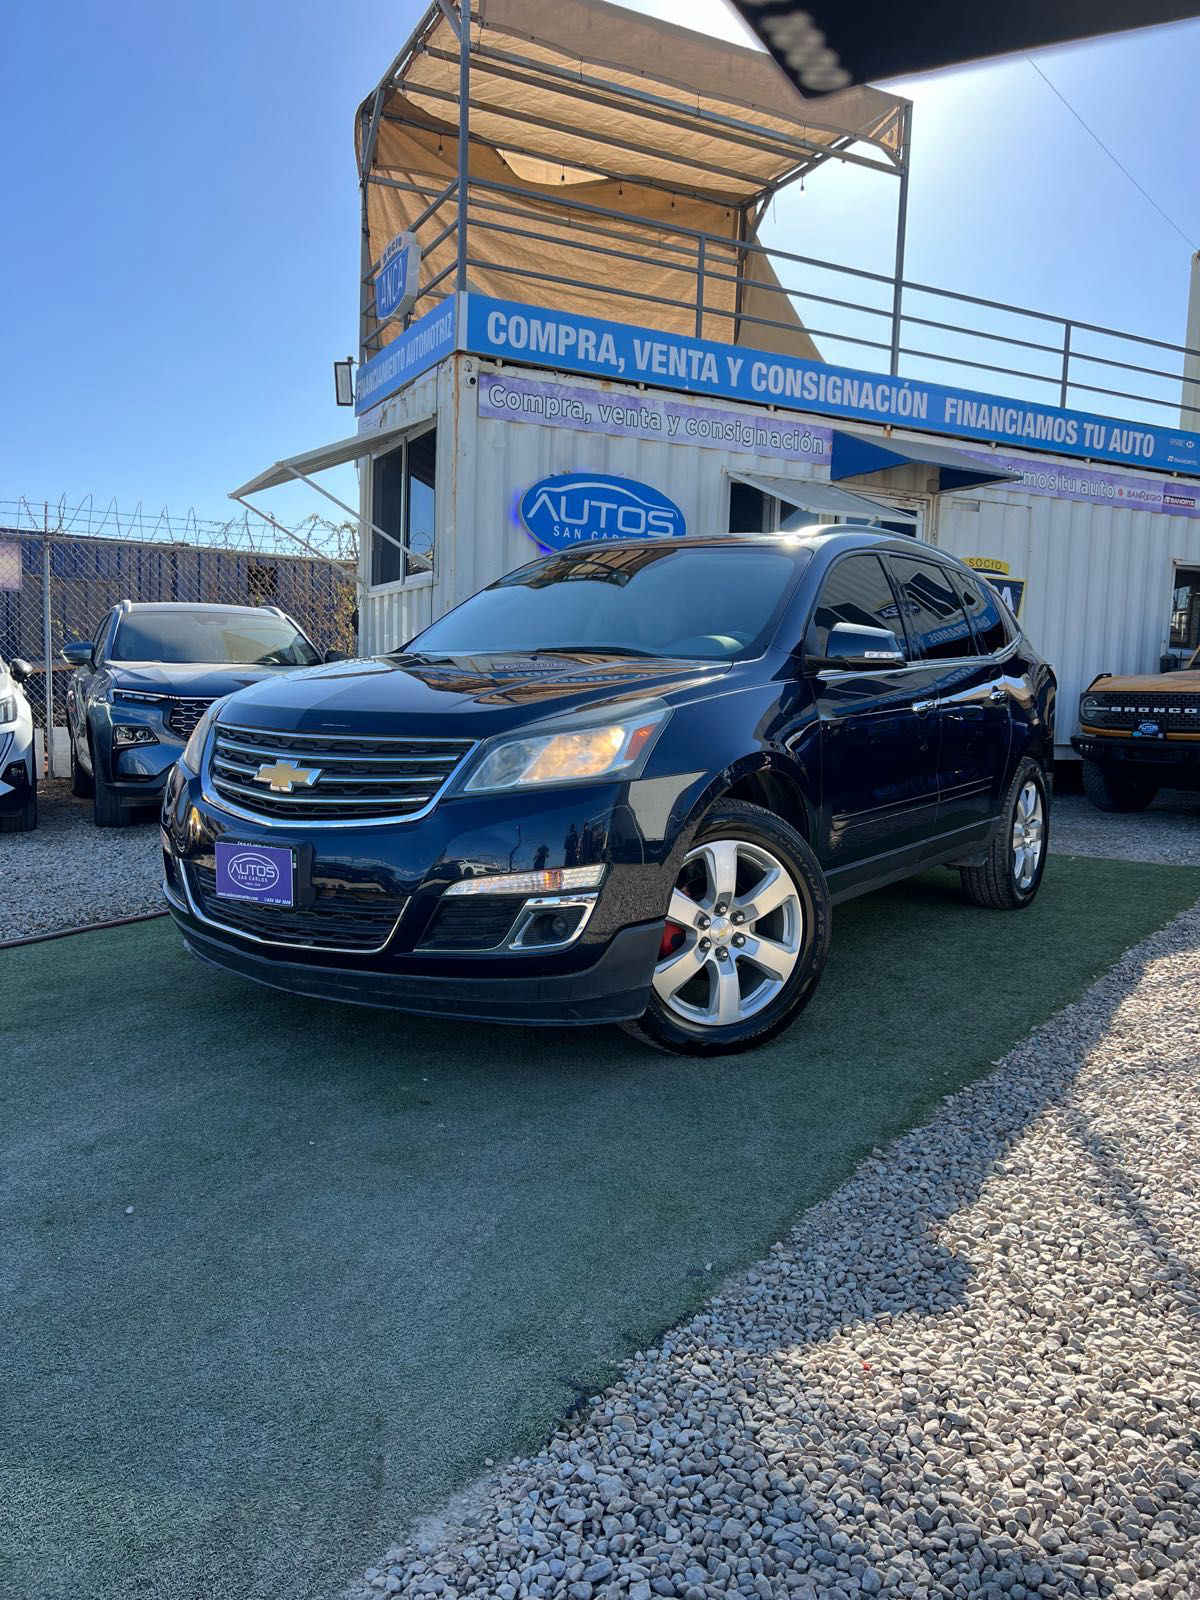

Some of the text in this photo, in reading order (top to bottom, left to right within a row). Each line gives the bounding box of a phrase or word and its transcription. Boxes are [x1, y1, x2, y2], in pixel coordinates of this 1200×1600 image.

[487, 311, 928, 419] COMPRA, VENTA Y CONSIGNACIÓN
[488, 384, 824, 454] Compra, venta y consignación
[944, 397, 1155, 458] FINANCIAMOS TU AUTO
[1058, 473, 1078, 492] tu
[1080, 480, 1116, 499] auto
[526, 493, 674, 537] AUTOS
[553, 524, 582, 539] SAN
[1110, 706, 1197, 714] BRONCO
[231, 863, 275, 878] AUTOS
